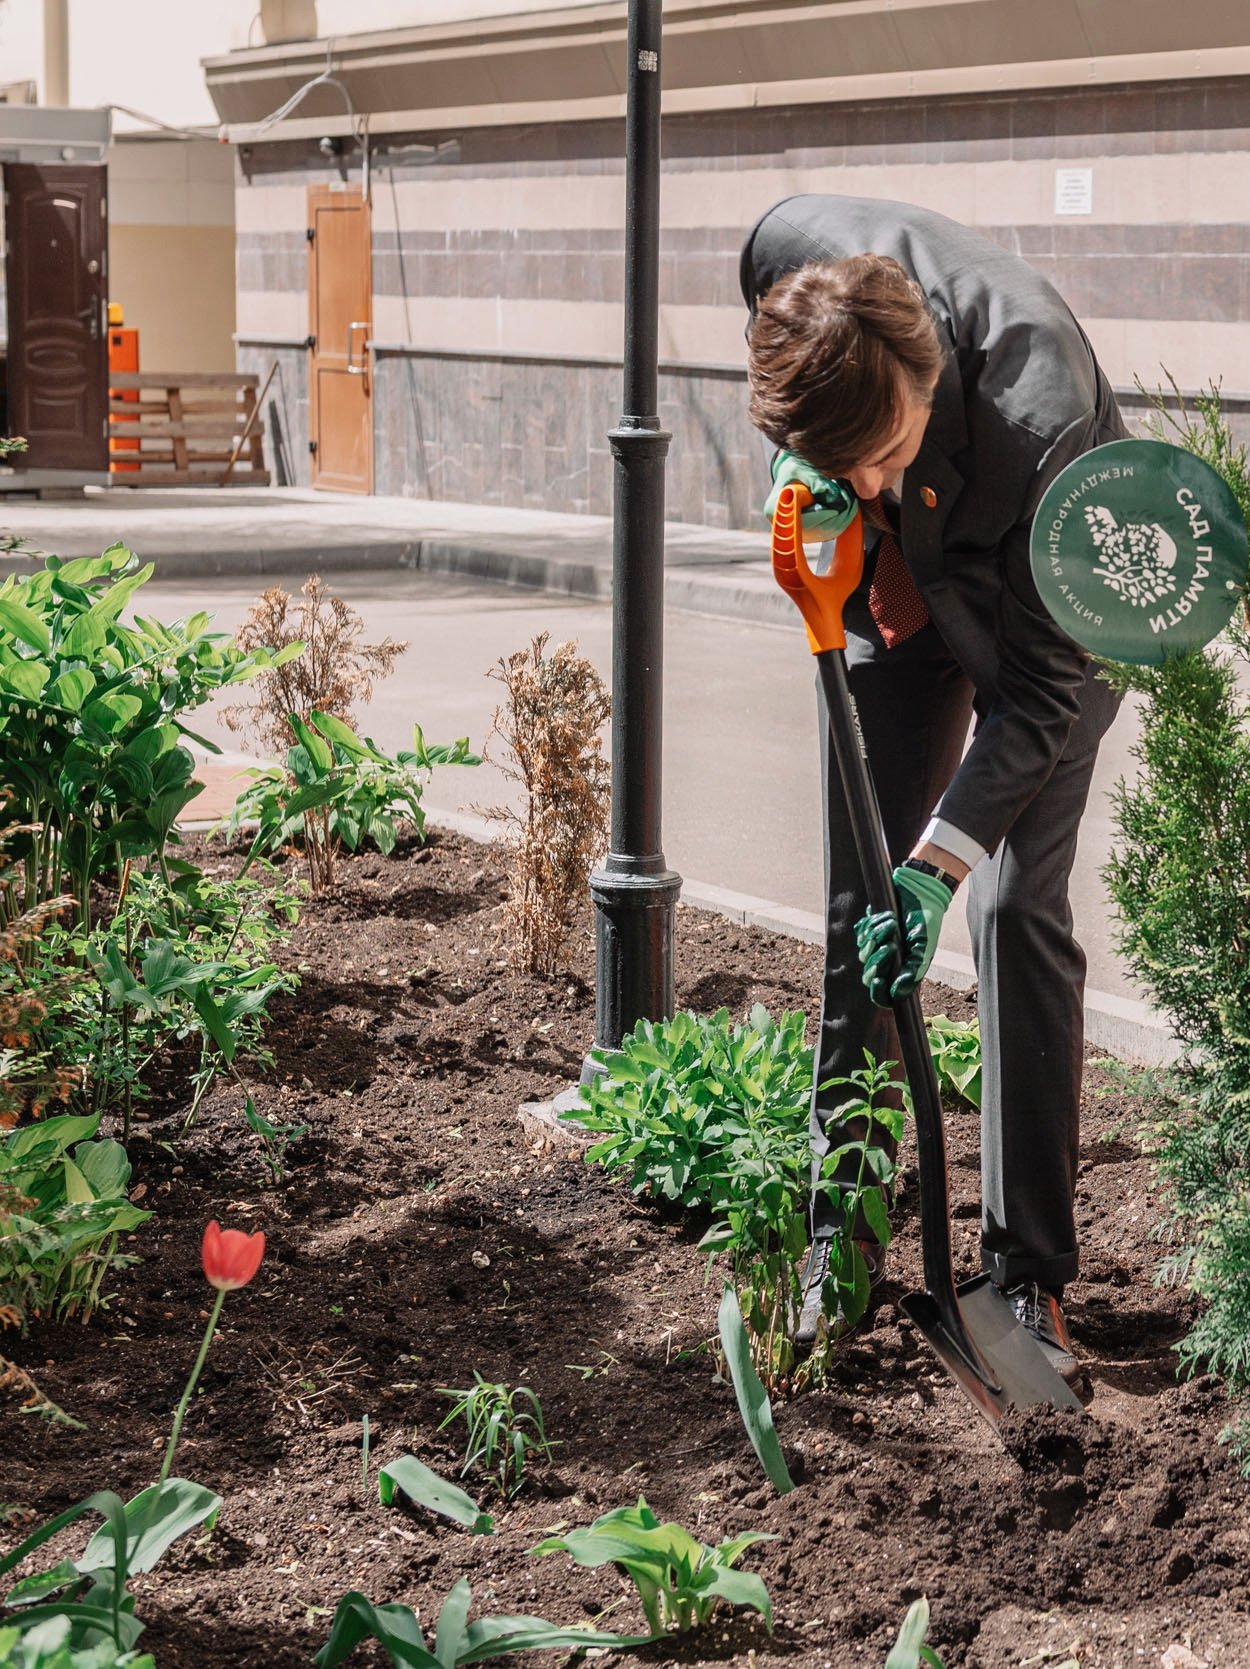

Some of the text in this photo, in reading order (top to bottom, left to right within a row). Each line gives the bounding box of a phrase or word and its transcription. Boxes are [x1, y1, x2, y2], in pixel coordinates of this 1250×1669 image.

[1048, 466, 1134, 626] МЕЖДУНАРОДНАЯ АКЦИЯ
[1149, 487, 1213, 634] САД ПАМЯТИ
